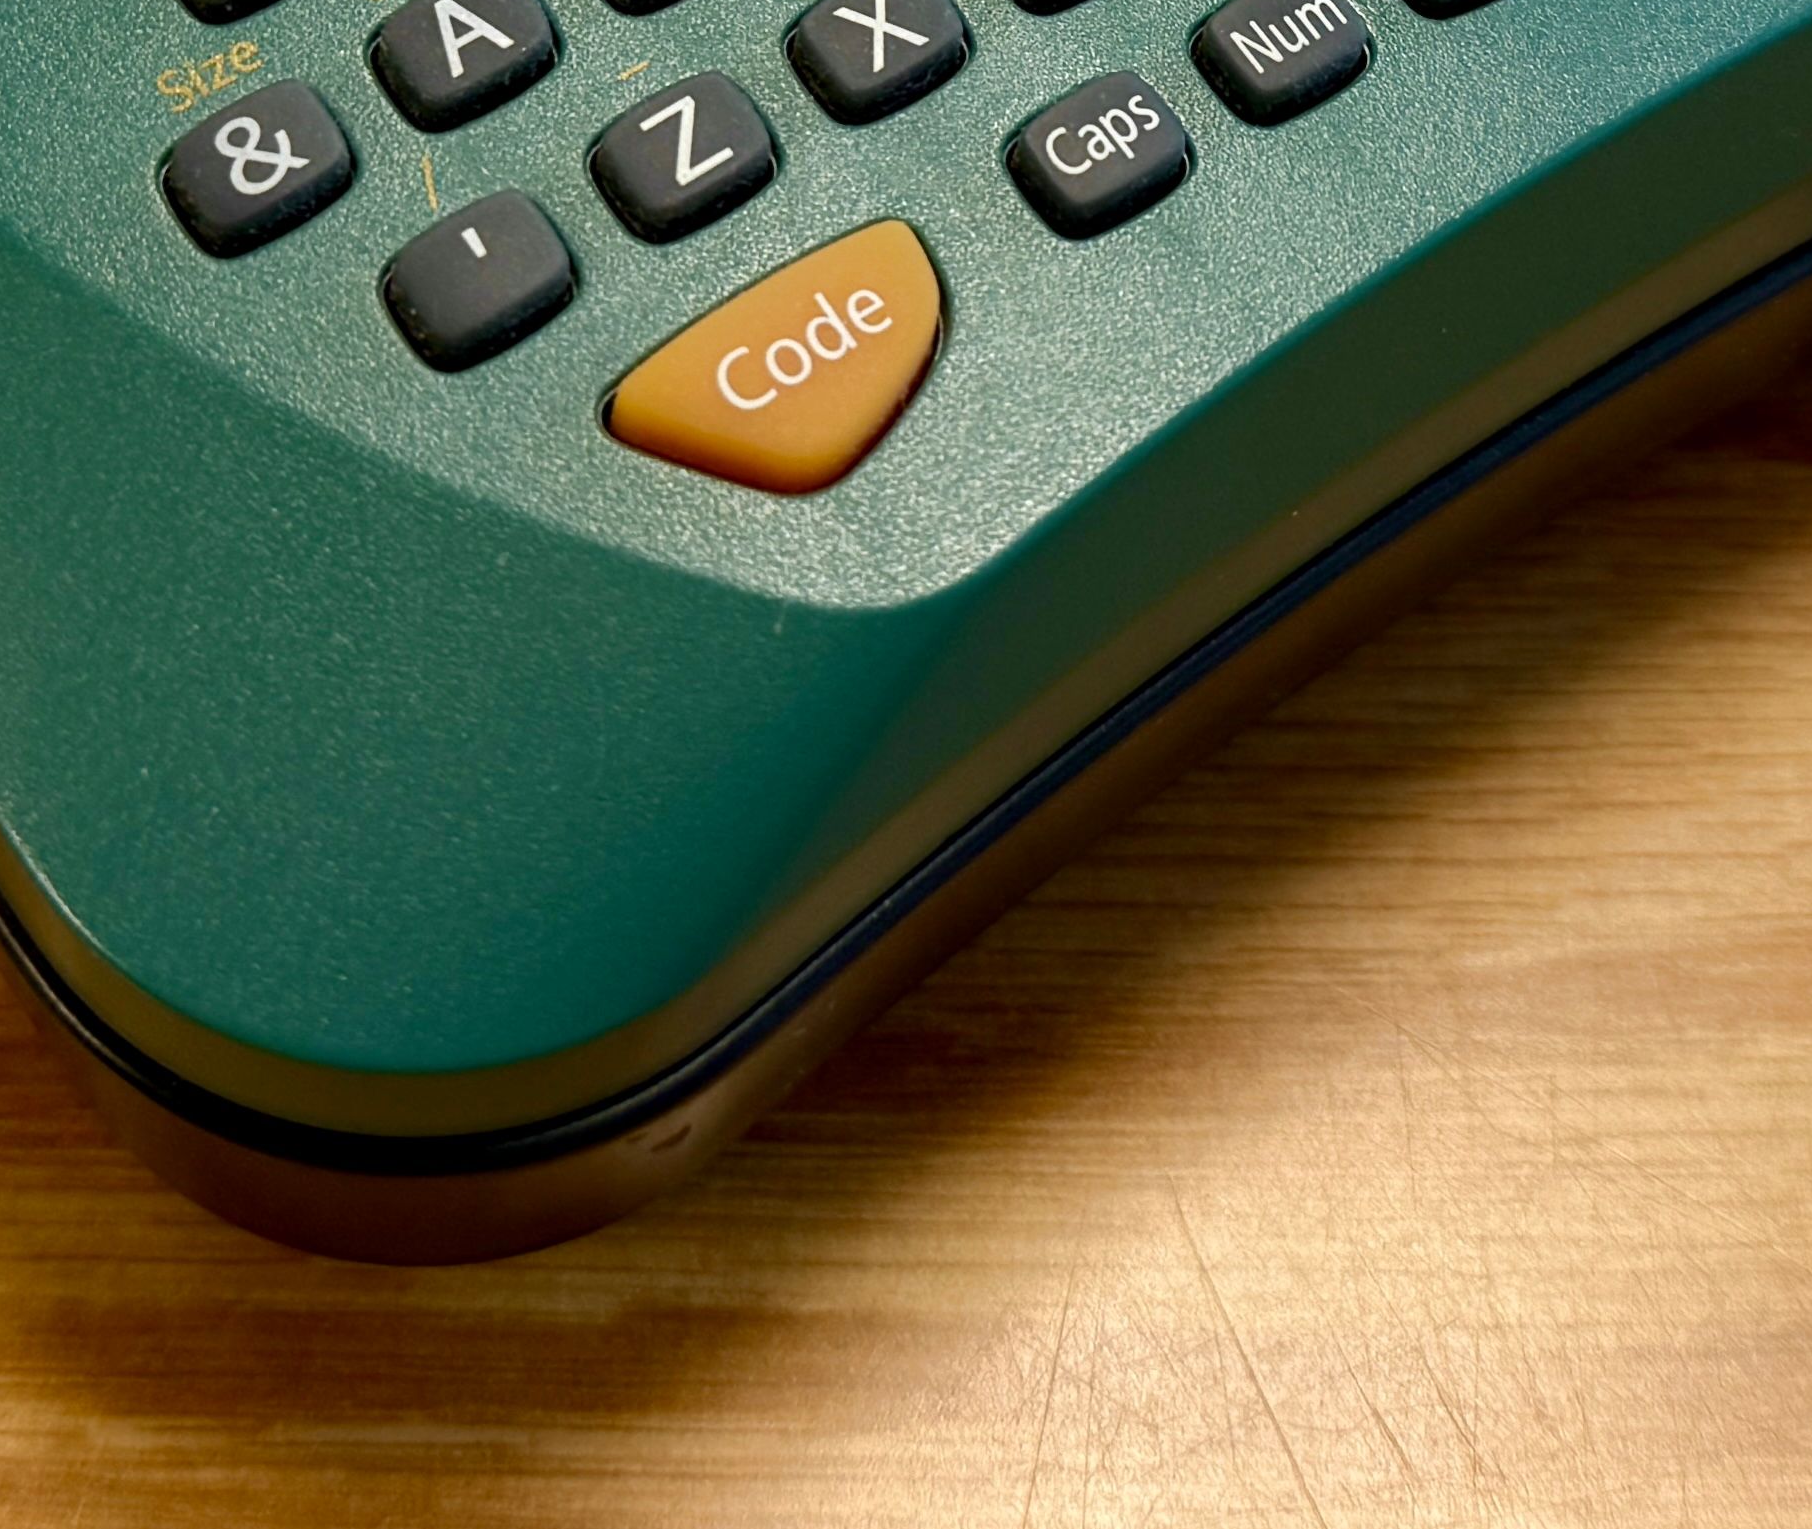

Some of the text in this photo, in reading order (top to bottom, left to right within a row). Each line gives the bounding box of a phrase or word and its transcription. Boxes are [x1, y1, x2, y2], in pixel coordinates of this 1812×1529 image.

[157, 42, 263, 113] Size
[215, 117, 309, 194] &
[639, 94, 734, 186] Z
[1045, 93, 1161, 175] Caps
[717, 286, 892, 409] Code
